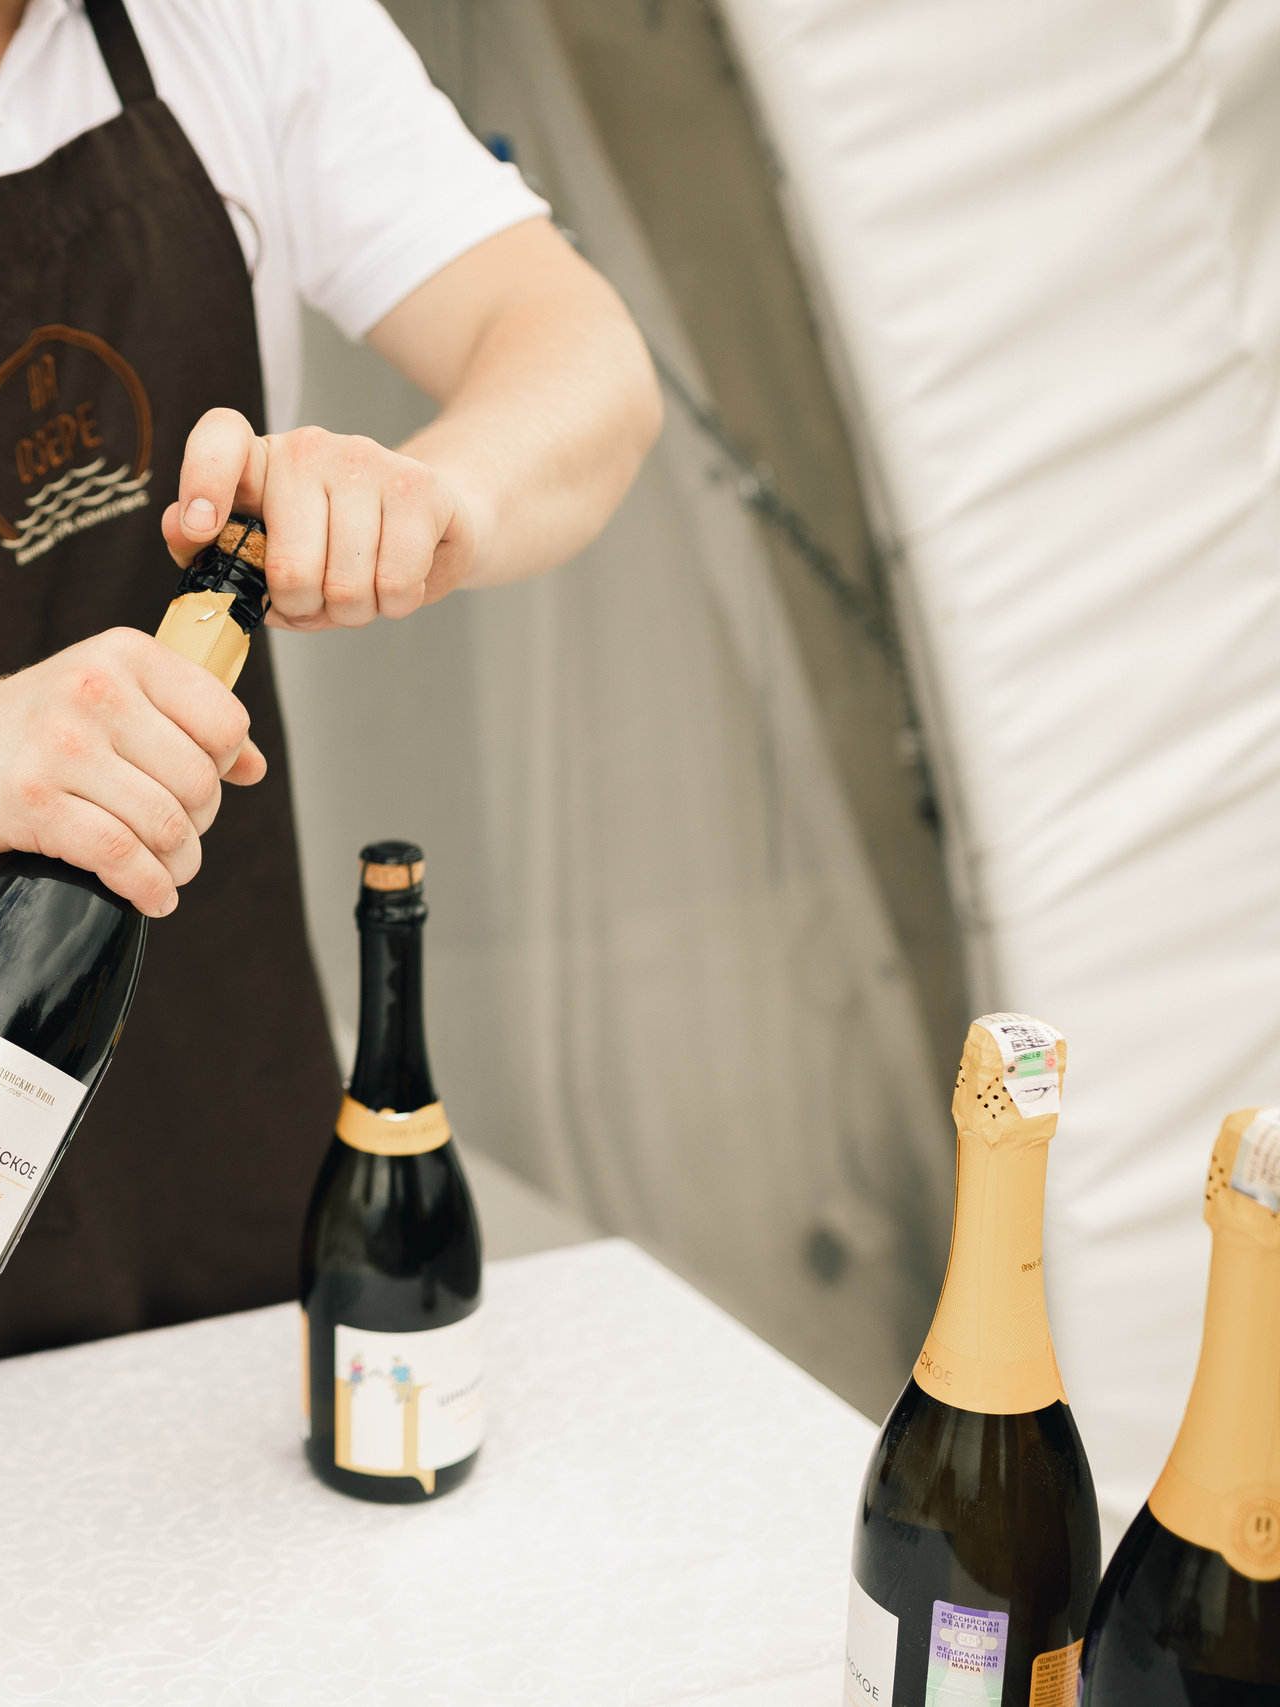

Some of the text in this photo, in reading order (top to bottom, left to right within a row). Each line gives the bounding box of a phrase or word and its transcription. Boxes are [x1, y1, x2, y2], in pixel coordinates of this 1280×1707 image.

[941, 1611, 1000, 1628] РОССИЙСКАЯ
[941, 1617, 999, 1634] ФЕДЕРАЦИЯ
[936, 1645, 999, 1662] ФЕДЕРАЛЬНАЯ
[936, 1651, 999, 1669] СПЕЦИАЛЬНАЯ
[951, 1662, 981, 1673] МАРКА
